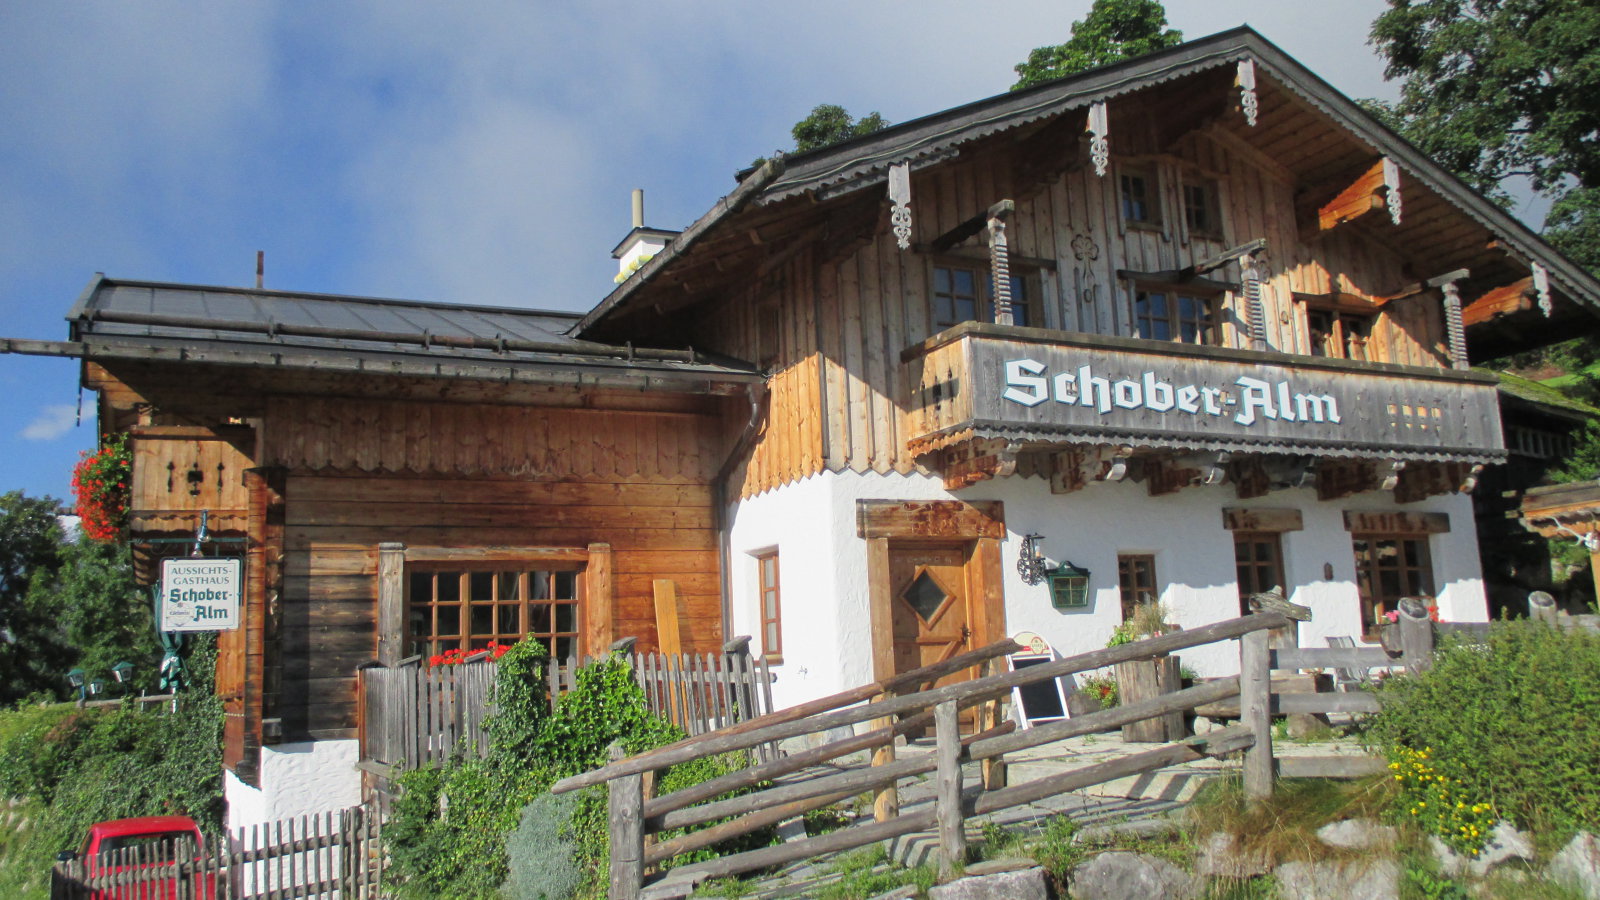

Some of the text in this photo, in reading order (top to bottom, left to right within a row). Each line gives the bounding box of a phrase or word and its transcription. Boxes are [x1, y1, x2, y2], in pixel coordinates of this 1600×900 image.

[1003, 358, 1341, 425] Schober-Alm
[169, 588, 232, 602] Schober-
[193, 605, 228, 622] Alm
